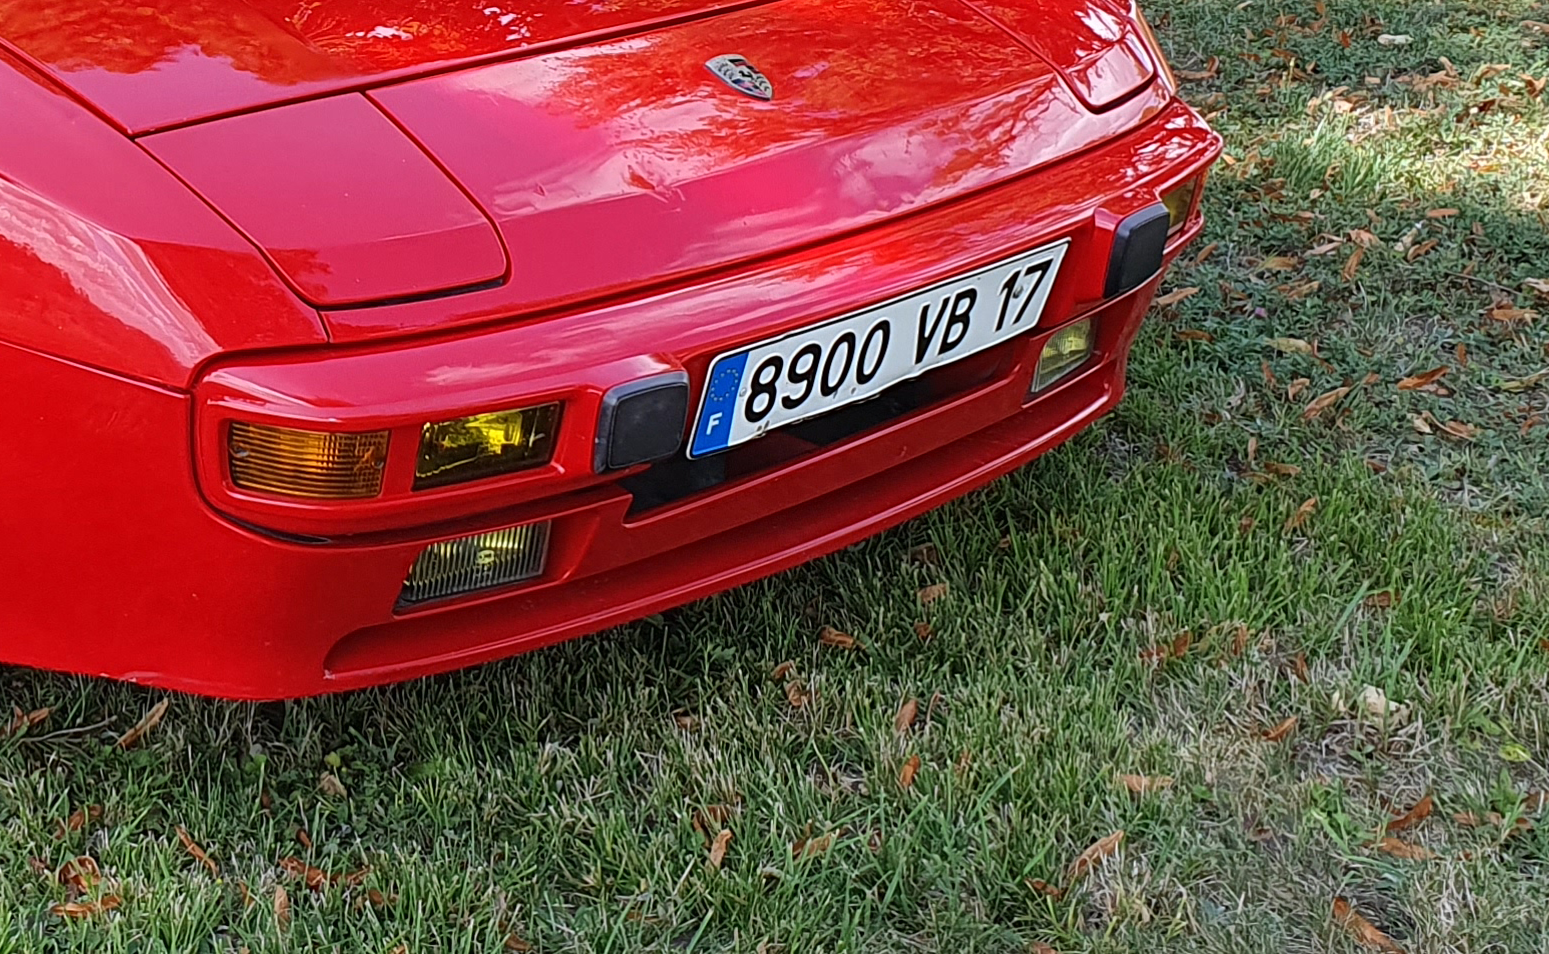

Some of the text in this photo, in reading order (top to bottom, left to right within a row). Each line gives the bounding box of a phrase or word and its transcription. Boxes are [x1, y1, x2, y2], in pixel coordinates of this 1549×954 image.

[743, 257, 1054, 424] 8900 VB 17
[705, 411, 723, 436] F
